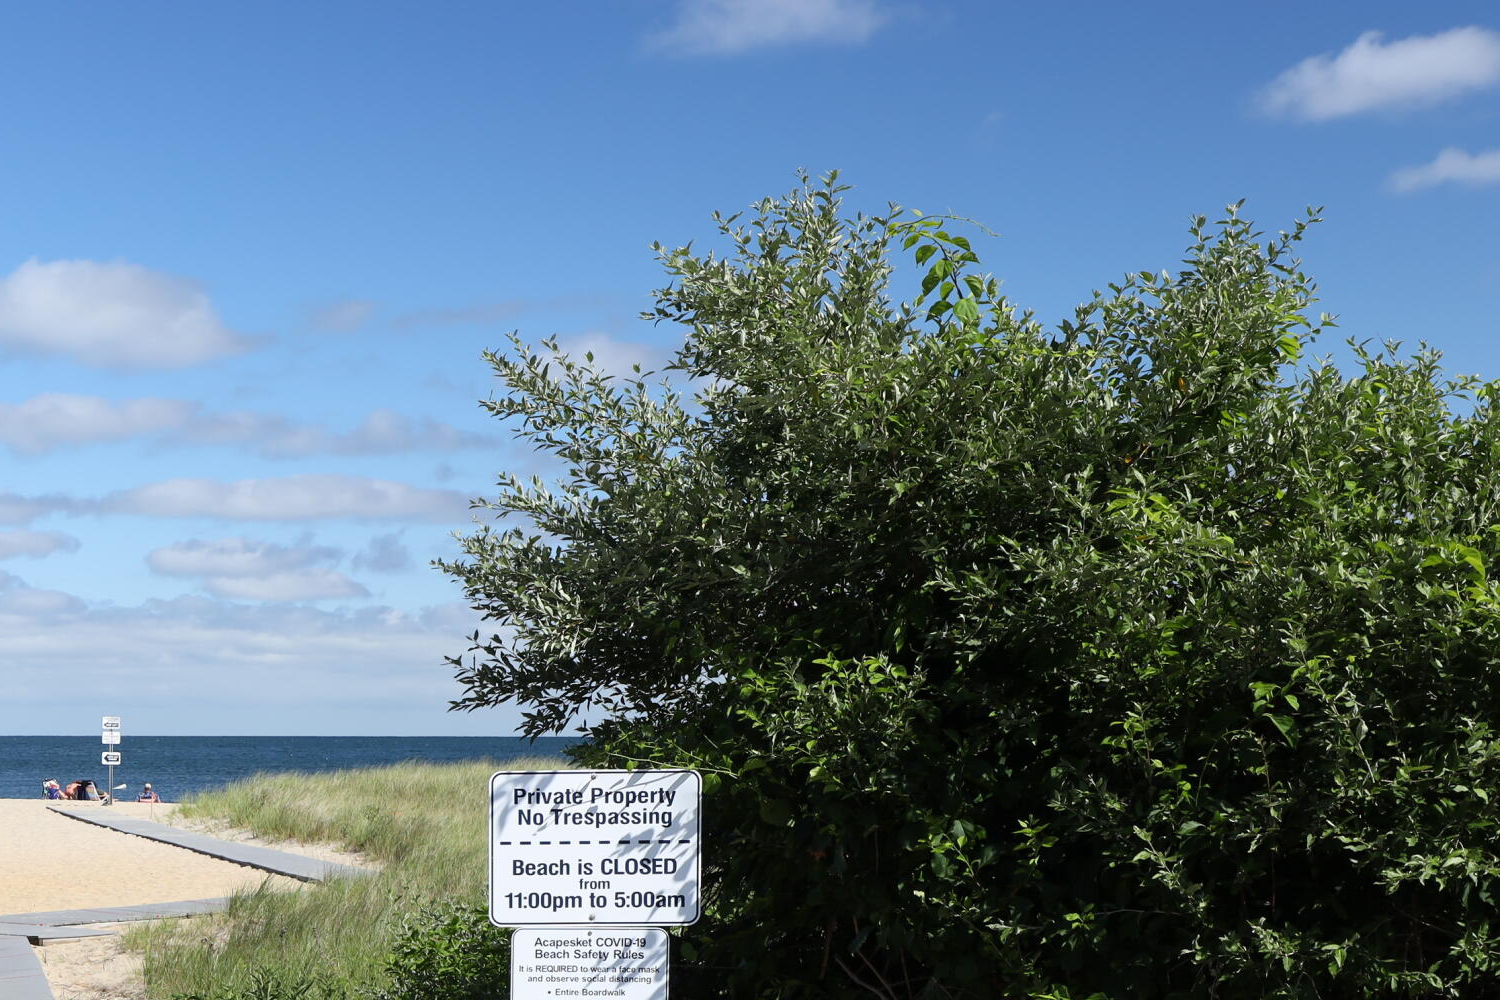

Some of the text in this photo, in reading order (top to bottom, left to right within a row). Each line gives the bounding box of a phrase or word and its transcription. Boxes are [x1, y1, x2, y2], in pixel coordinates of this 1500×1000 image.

[514, 788, 676, 806] Private Property
[518, 809, 672, 828] No Trespassing
[513, 858, 677, 876] Beach is CLOSED
[580, 879, 610, 889] from
[505, 892, 685, 912] 11:00pm to 5:00am
[535, 938, 646, 948] Acapesket COVID-19
[535, 950, 644, 961] Beach Safety Rules
[609, 975, 651, 984] distancing
